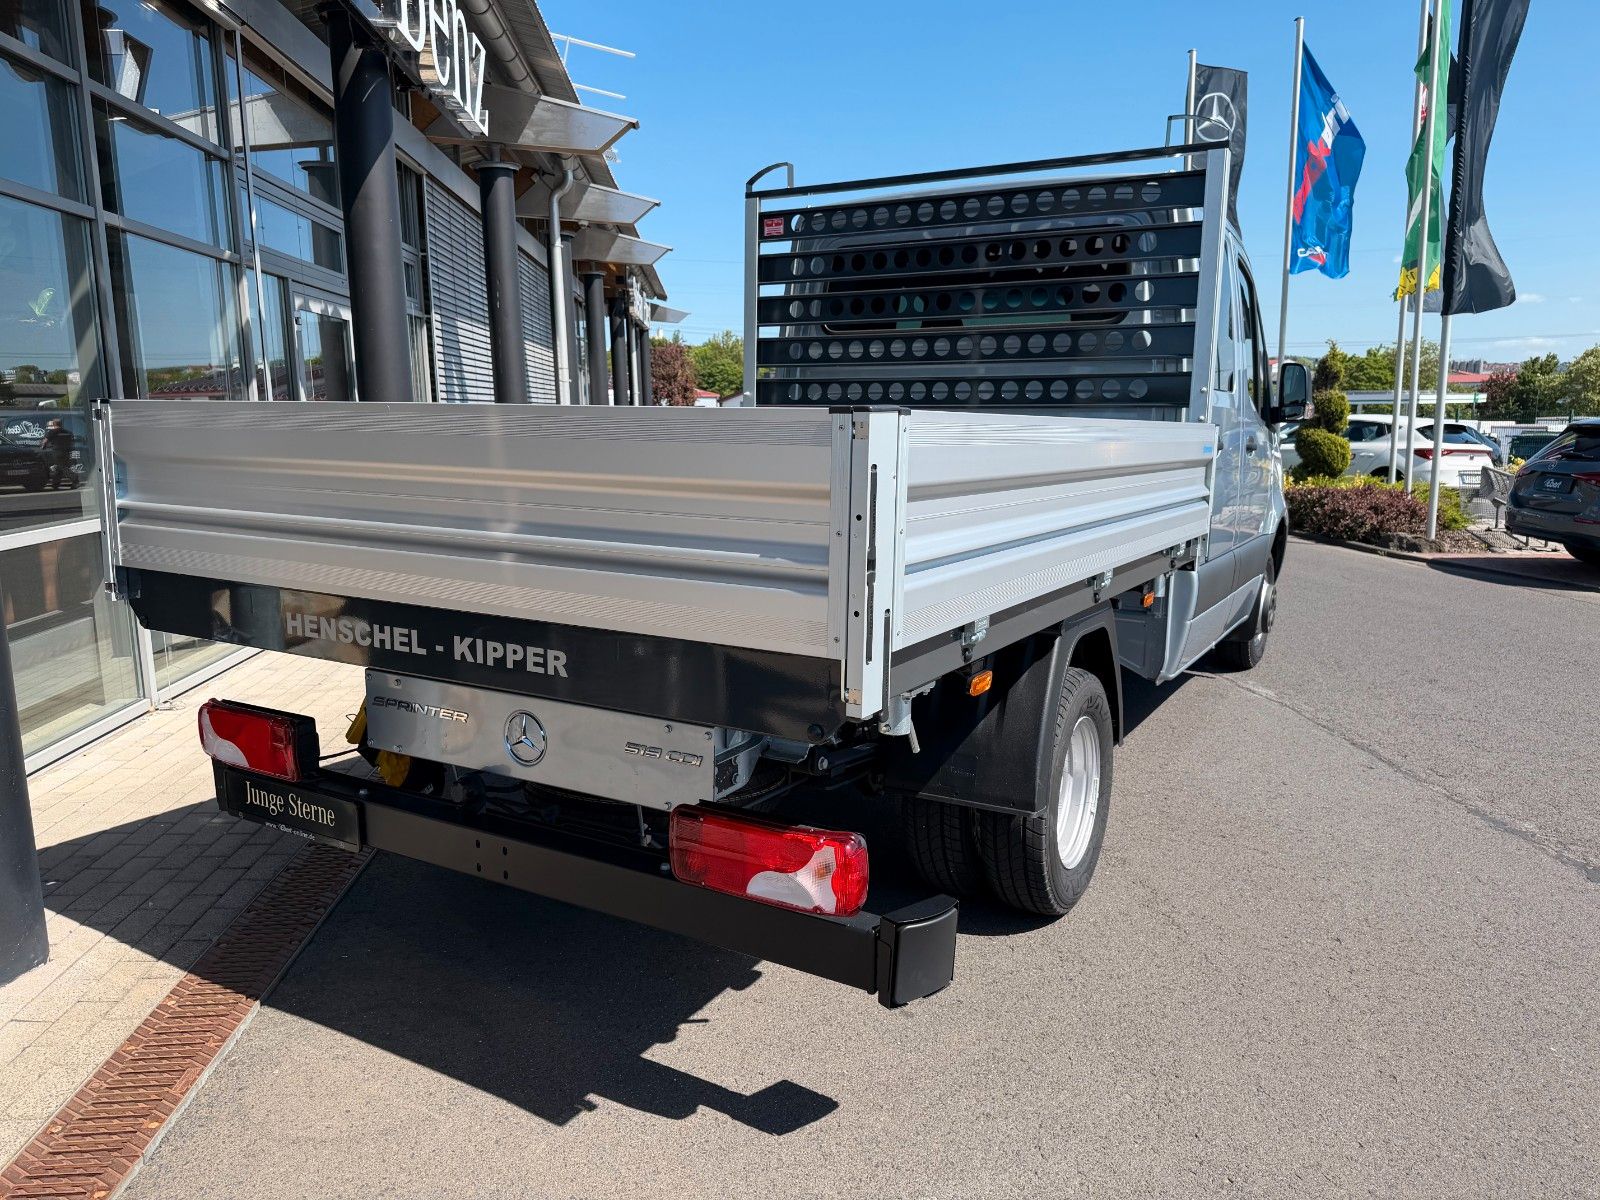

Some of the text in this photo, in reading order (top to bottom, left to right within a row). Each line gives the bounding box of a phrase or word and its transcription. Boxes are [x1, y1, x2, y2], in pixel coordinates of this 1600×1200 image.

[286, 612, 427, 655] HENSCHEL
[453, 635, 568, 678] KIPPER
[372, 696, 469, 723] SPRINTER
[624, 742, 703, 767] 519 CDI
[245, 781, 335, 827] Junge Sterne
